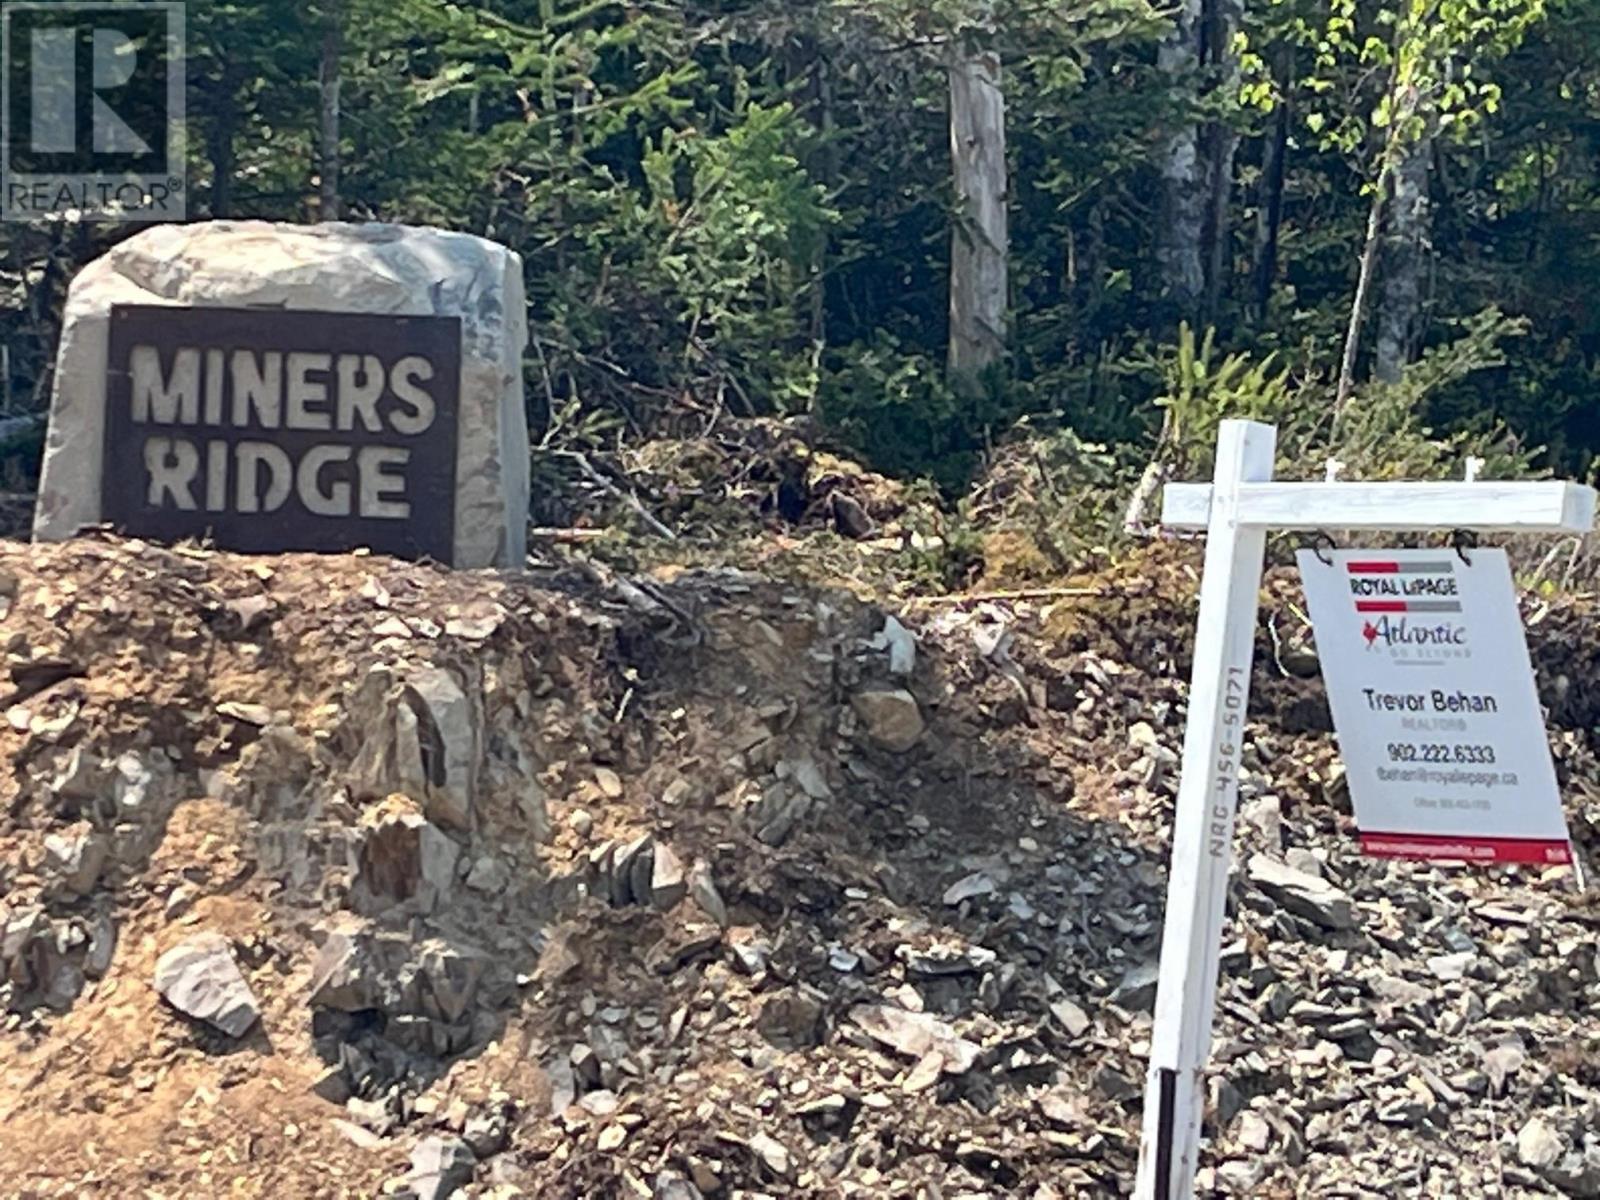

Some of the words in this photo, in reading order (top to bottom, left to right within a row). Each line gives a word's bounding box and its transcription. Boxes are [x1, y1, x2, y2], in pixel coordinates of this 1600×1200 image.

[130, 345, 436, 435] MINERS
[144, 437, 411, 519] RIDGE
[1350, 578, 1400, 595] ROYAL
[1375, 615, 1467, 646] Atlantic
[1362, 688, 1425, 711] Trevor
[1431, 690, 1497, 712] Behan
[1216, 666, 1243, 792] 456-5071
[1387, 743, 1495, 763] 902.222.6333
[1208, 805, 1229, 857] NRG
